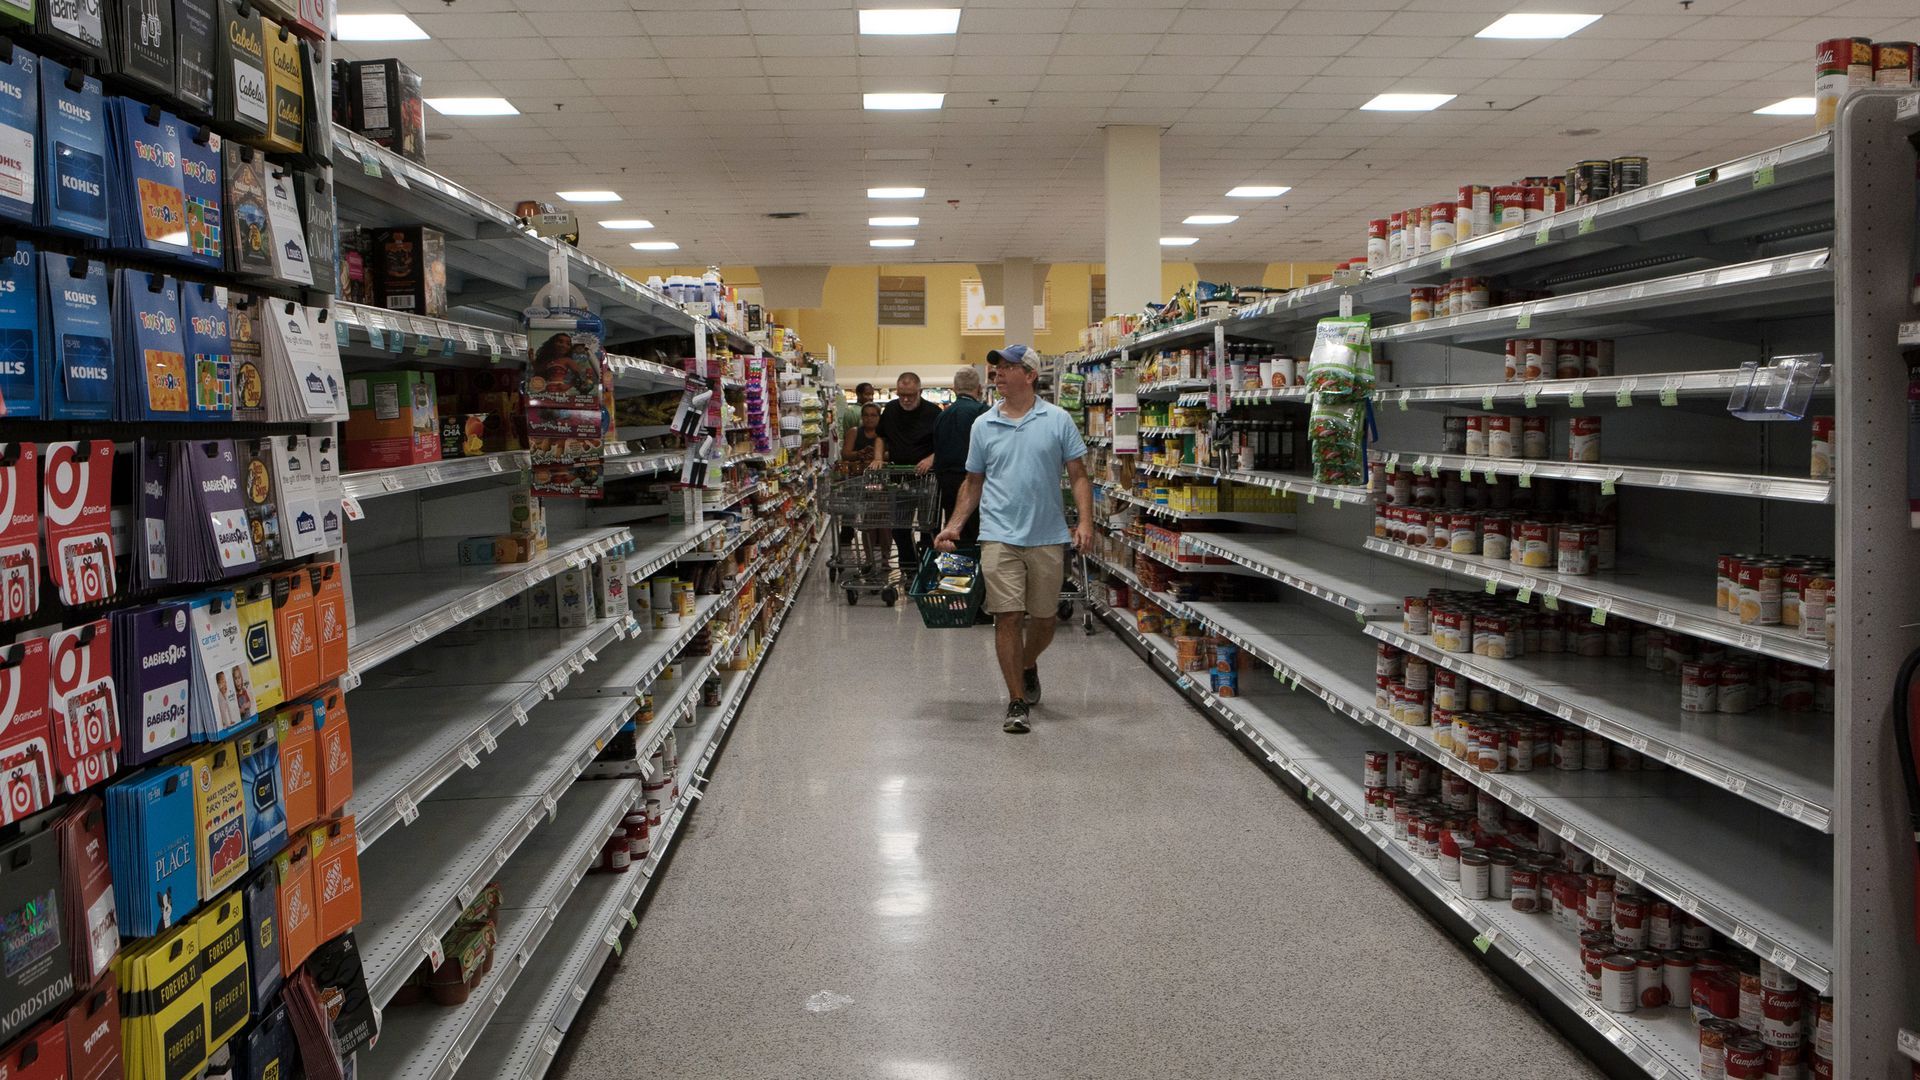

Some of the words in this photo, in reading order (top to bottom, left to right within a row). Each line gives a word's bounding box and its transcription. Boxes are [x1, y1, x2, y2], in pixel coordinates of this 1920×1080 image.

[59, 100, 91, 121] KOHL'S
[62, 174, 100, 197] KOHL'S
[1493, 192, 1523, 204] Campbell's
[896, 277, 905, 288] 7
[64, 290, 97, 306] KOHL'S
[70, 365, 108, 381] KOHL'S
[156, 843, 190, 882] PLACE
[208, 934, 234, 963] FOREVER
[234, 929, 240, 942] 21
[161, 972, 189, 1004] FOREVER
[190, 964, 196, 979] 21
[1, 973, 74, 1034] NORDSTROM
[214, 991, 240, 1015] FOREVER
[240, 981, 246, 996] 21
[353, 1020, 369, 1036] WHAT
[168, 1032, 195, 1062] FOREVER
[195, 1023, 202, 1041] 21
